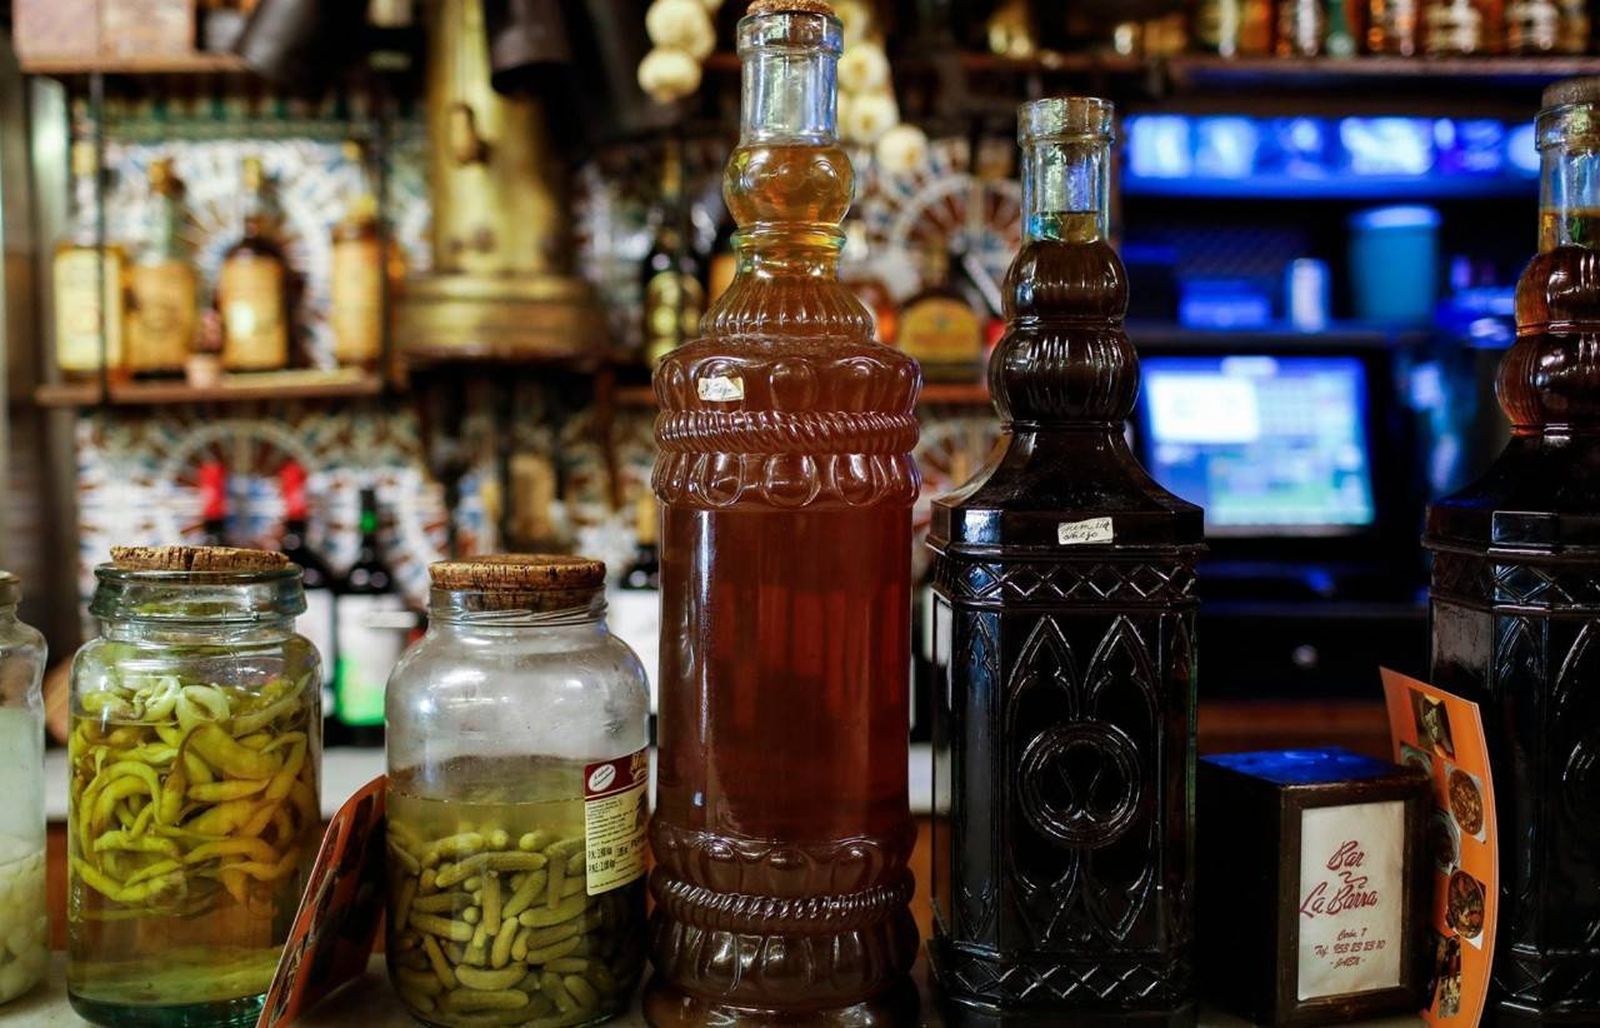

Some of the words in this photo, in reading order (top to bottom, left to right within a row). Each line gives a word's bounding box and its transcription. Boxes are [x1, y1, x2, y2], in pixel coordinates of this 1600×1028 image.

[1326, 840, 1364, 870] Bar
[1300, 881, 1327, 918] La
[1326, 884, 1378, 915] Barra
